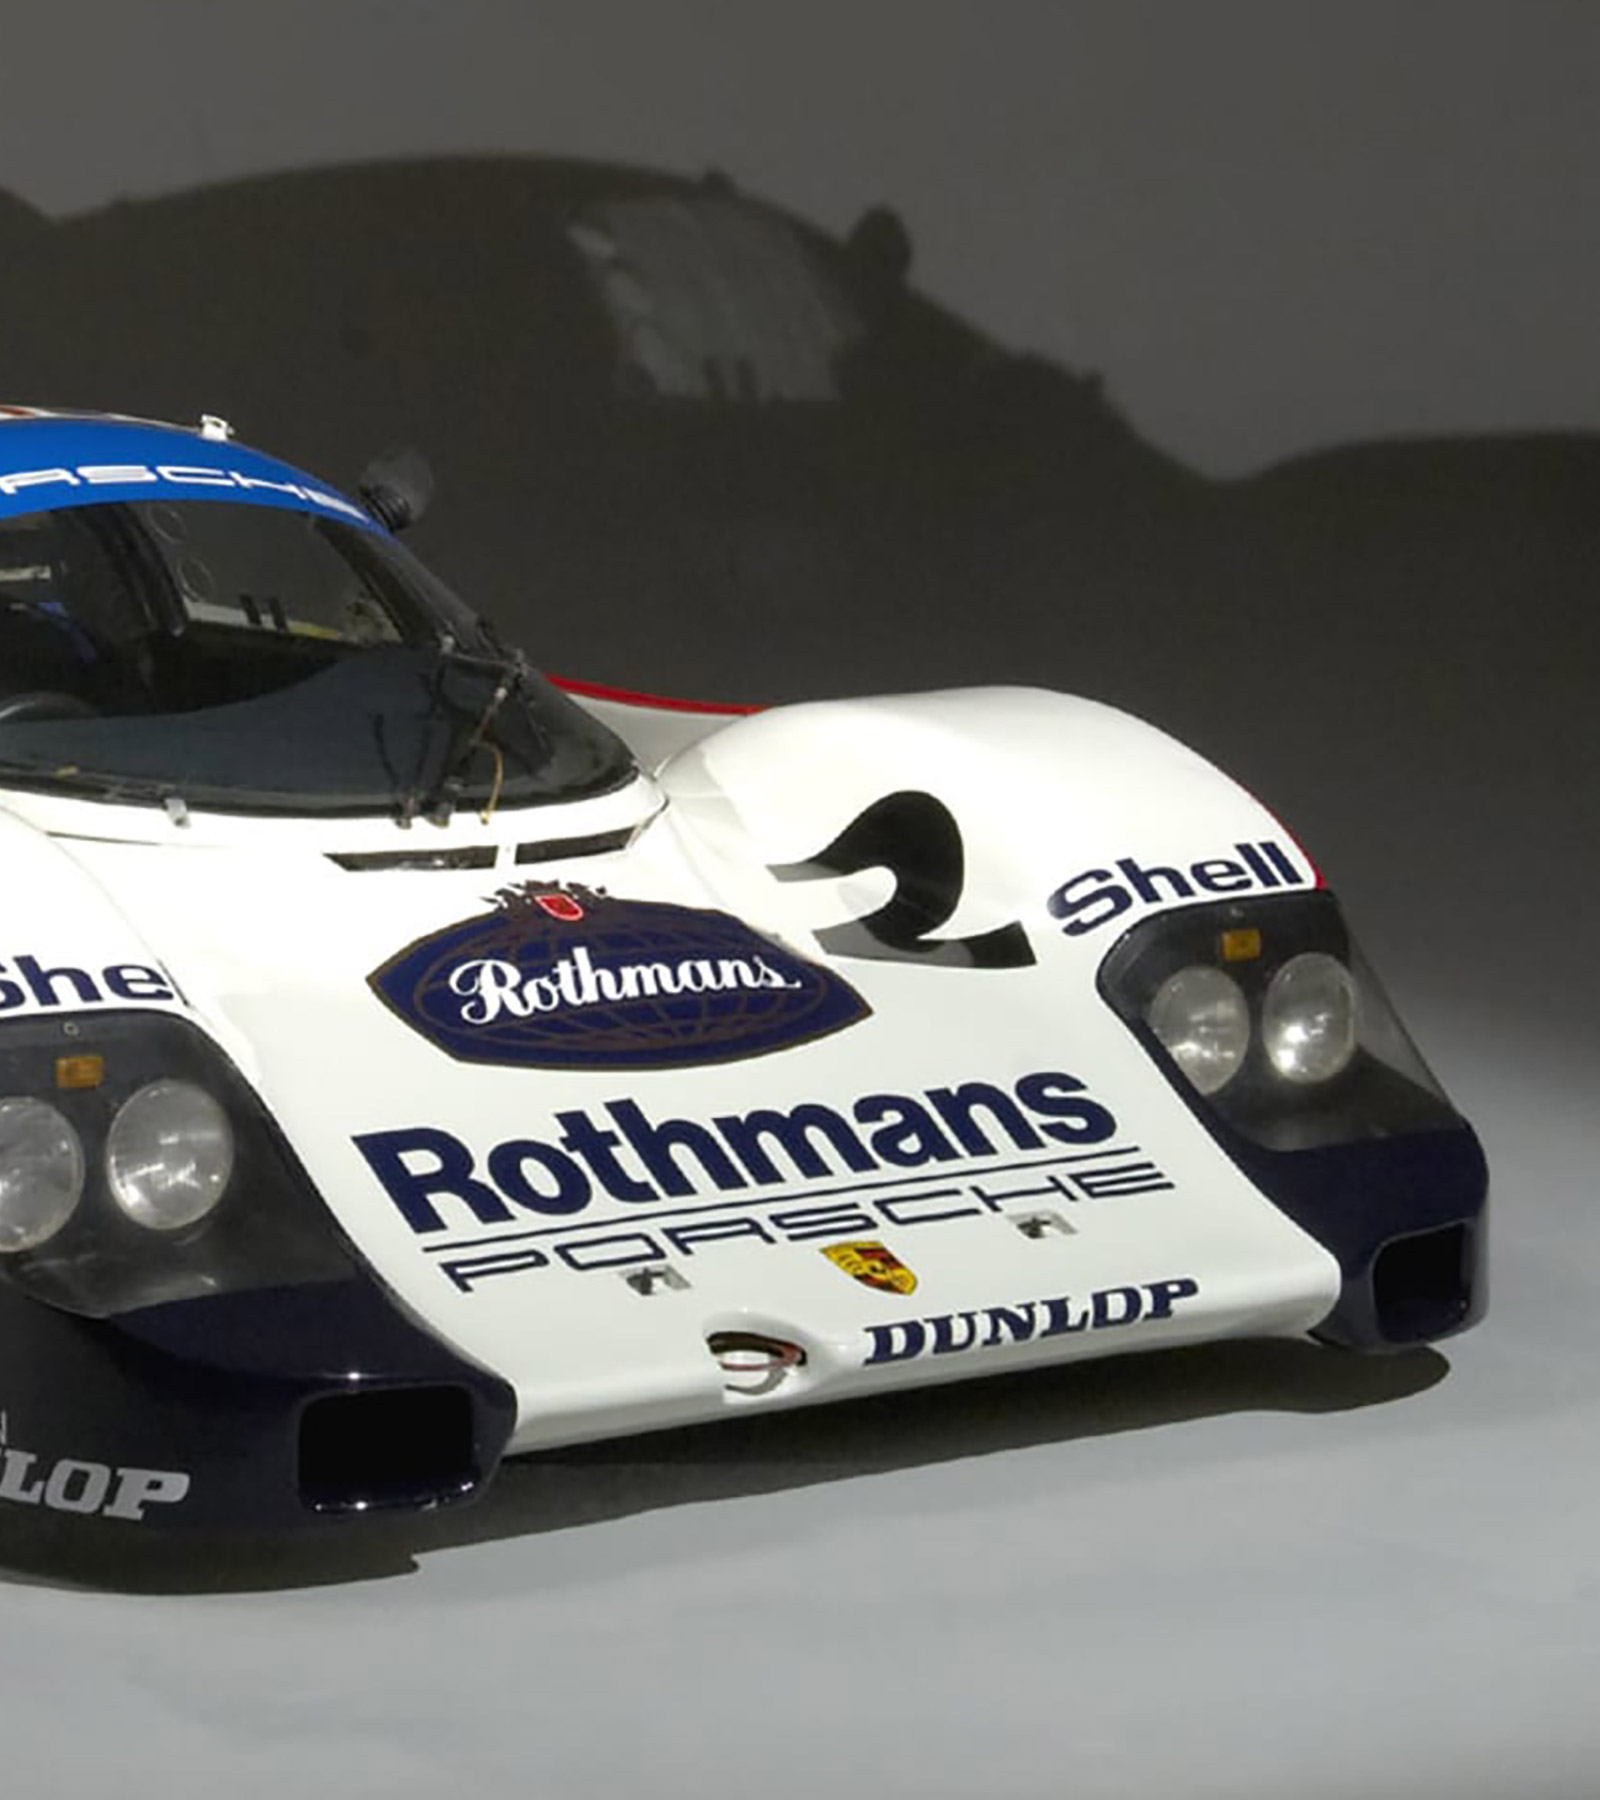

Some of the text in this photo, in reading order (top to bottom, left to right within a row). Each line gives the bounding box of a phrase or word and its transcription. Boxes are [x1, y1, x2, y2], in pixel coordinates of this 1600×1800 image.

[765, 790, 1037, 970] 2
[1047, 841, 1304, 937] Shell
[449, 946, 801, 1026] Rothmans
[352, 1071, 1118, 1234] Rothmans
[437, 1161, 1175, 1293] PORSCHE
[863, 1277, 1200, 1367] DUNLOP
